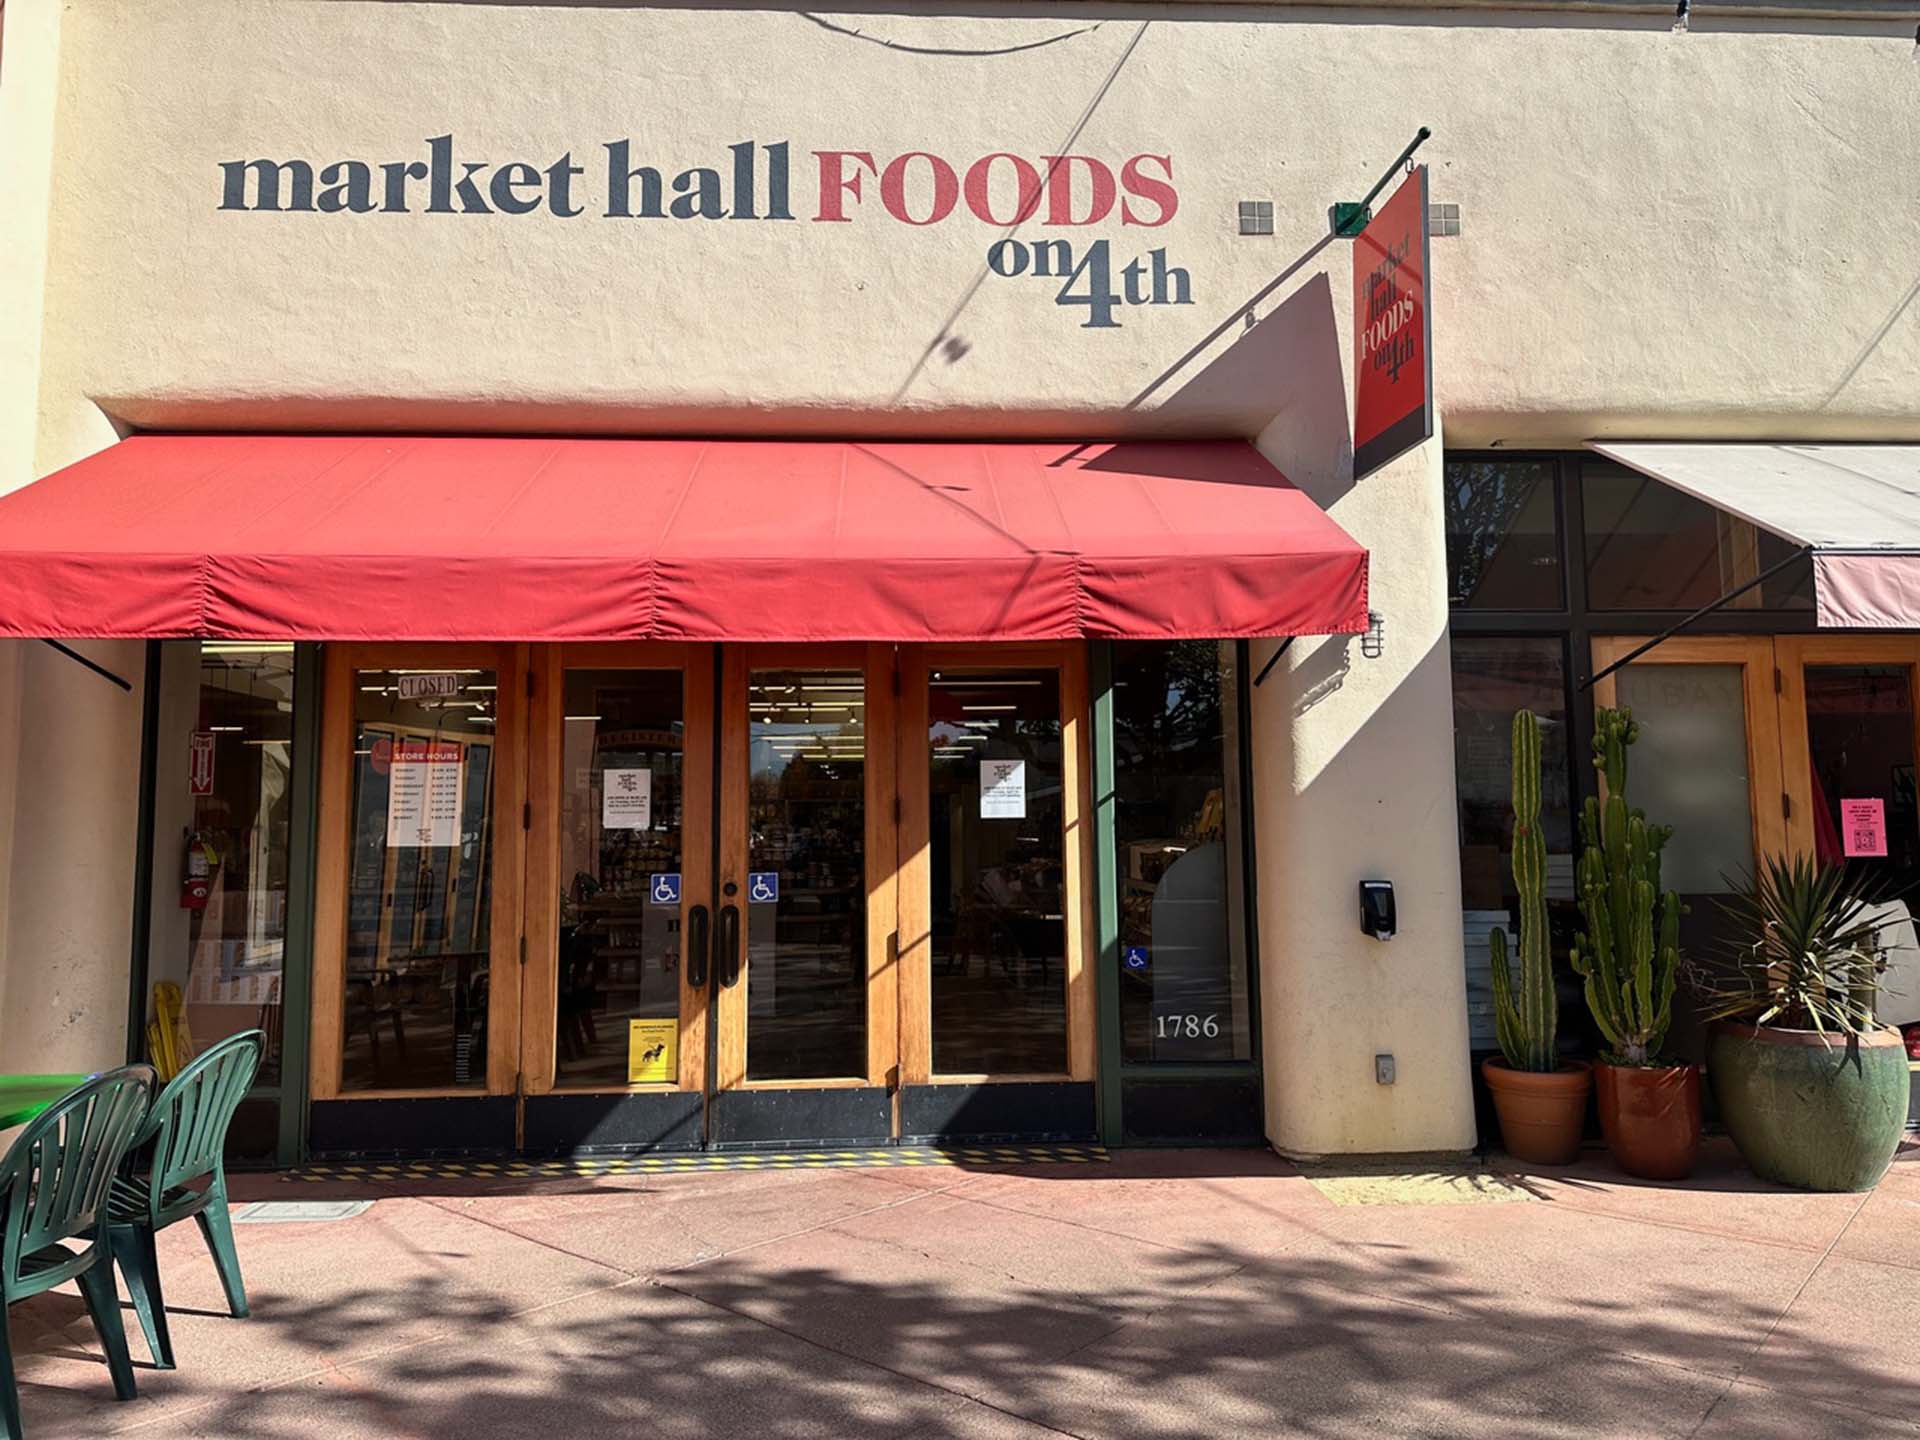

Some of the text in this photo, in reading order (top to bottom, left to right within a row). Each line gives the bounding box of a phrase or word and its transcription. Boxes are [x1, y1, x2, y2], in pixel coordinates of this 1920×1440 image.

[217, 134, 1179, 227] market hall FOODS
[1361, 288, 1414, 361] FOODS
[400, 676, 456, 697] CLOSED
[394, 752, 424, 761] STORE
[427, 752, 459, 761] HOURS
[1157, 1014, 1219, 1038] 1786
